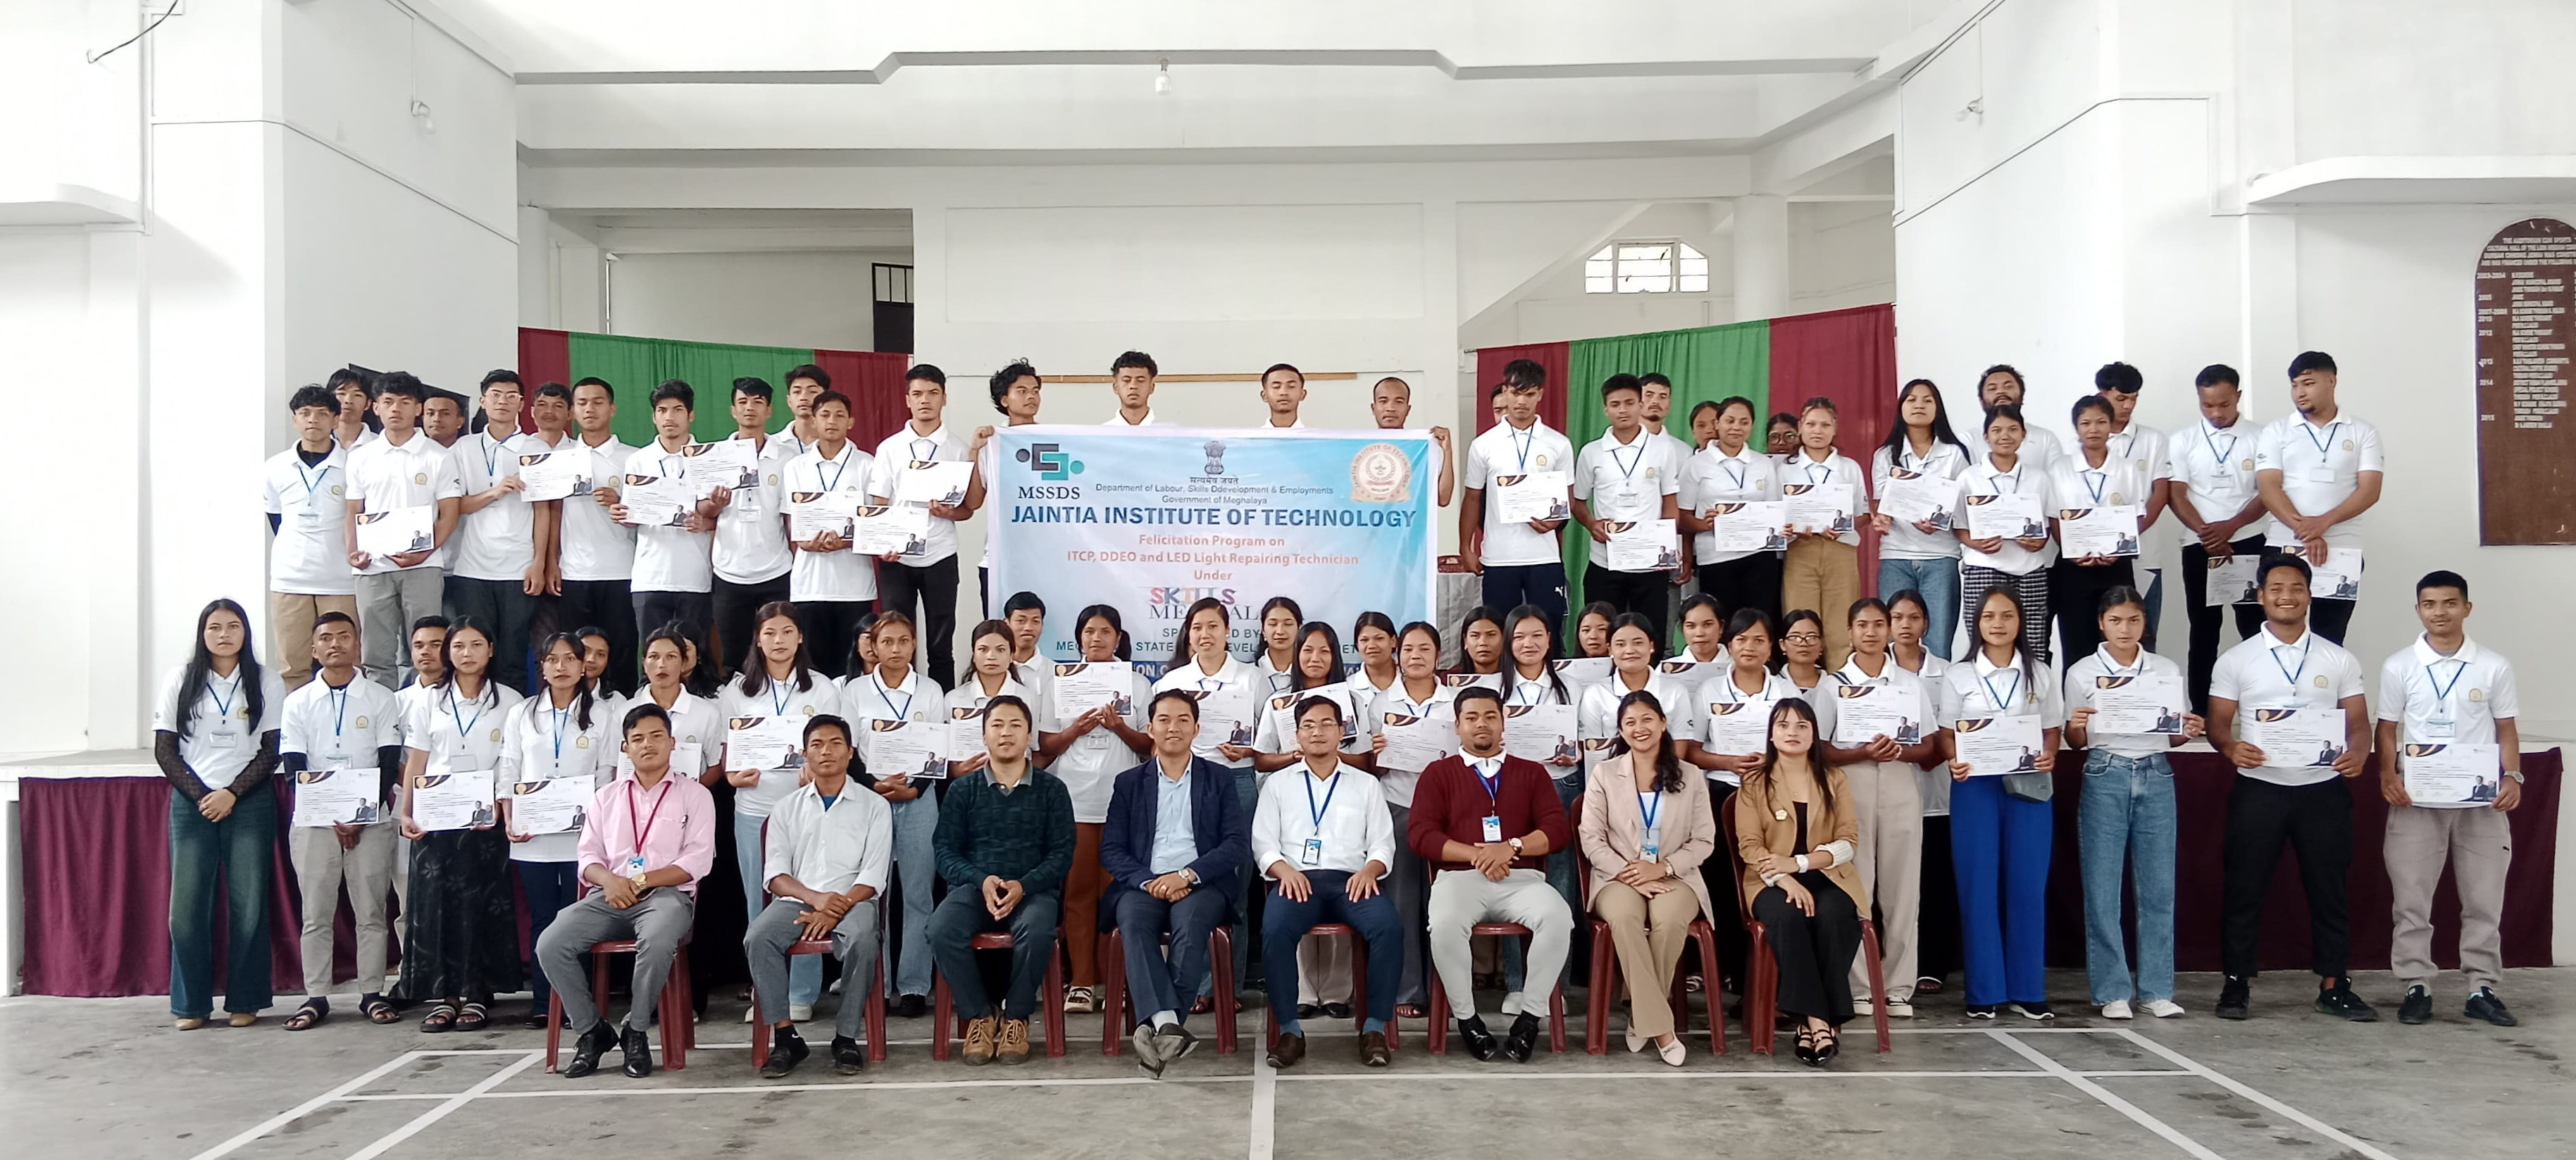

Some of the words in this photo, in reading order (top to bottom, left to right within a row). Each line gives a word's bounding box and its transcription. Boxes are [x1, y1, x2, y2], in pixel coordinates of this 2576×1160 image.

[1018, 486, 1081, 499] MSSDS
[1095, 483, 1143, 492] Department
[1188, 485, 1209, 493] Skills
[1279, 486, 1334, 496] Employments
[1162, 495, 1212, 504] Government
[1223, 497, 1268, 506] Meghalaya
[1012, 506, 1098, 524] JAINTIA
[1105, 507, 1221, 525] INSTITUTE
[1227, 509, 1257, 525] OF
[1262, 509, 1417, 528] TECHNOLOGY
[1139, 534, 1209, 546] Felicitation
[1212, 535, 1266, 549] Program
[1269, 537, 1285, 547] on
[1067, 551, 1097, 563] ITCP,
[1100, 551, 1137, 561] DDEO
[1140, 551, 1164, 562] and
[1166, 552, 1191, 563] LED
[1195, 553, 1226, 566] Light
[1230, 553, 1290, 566] Repairing
[1293, 554, 1359, 565] Technician
[1194, 569, 1233, 580] Under
[1244, 629, 1260, 638] BY
[1135, 642, 1174, 651] STATE
